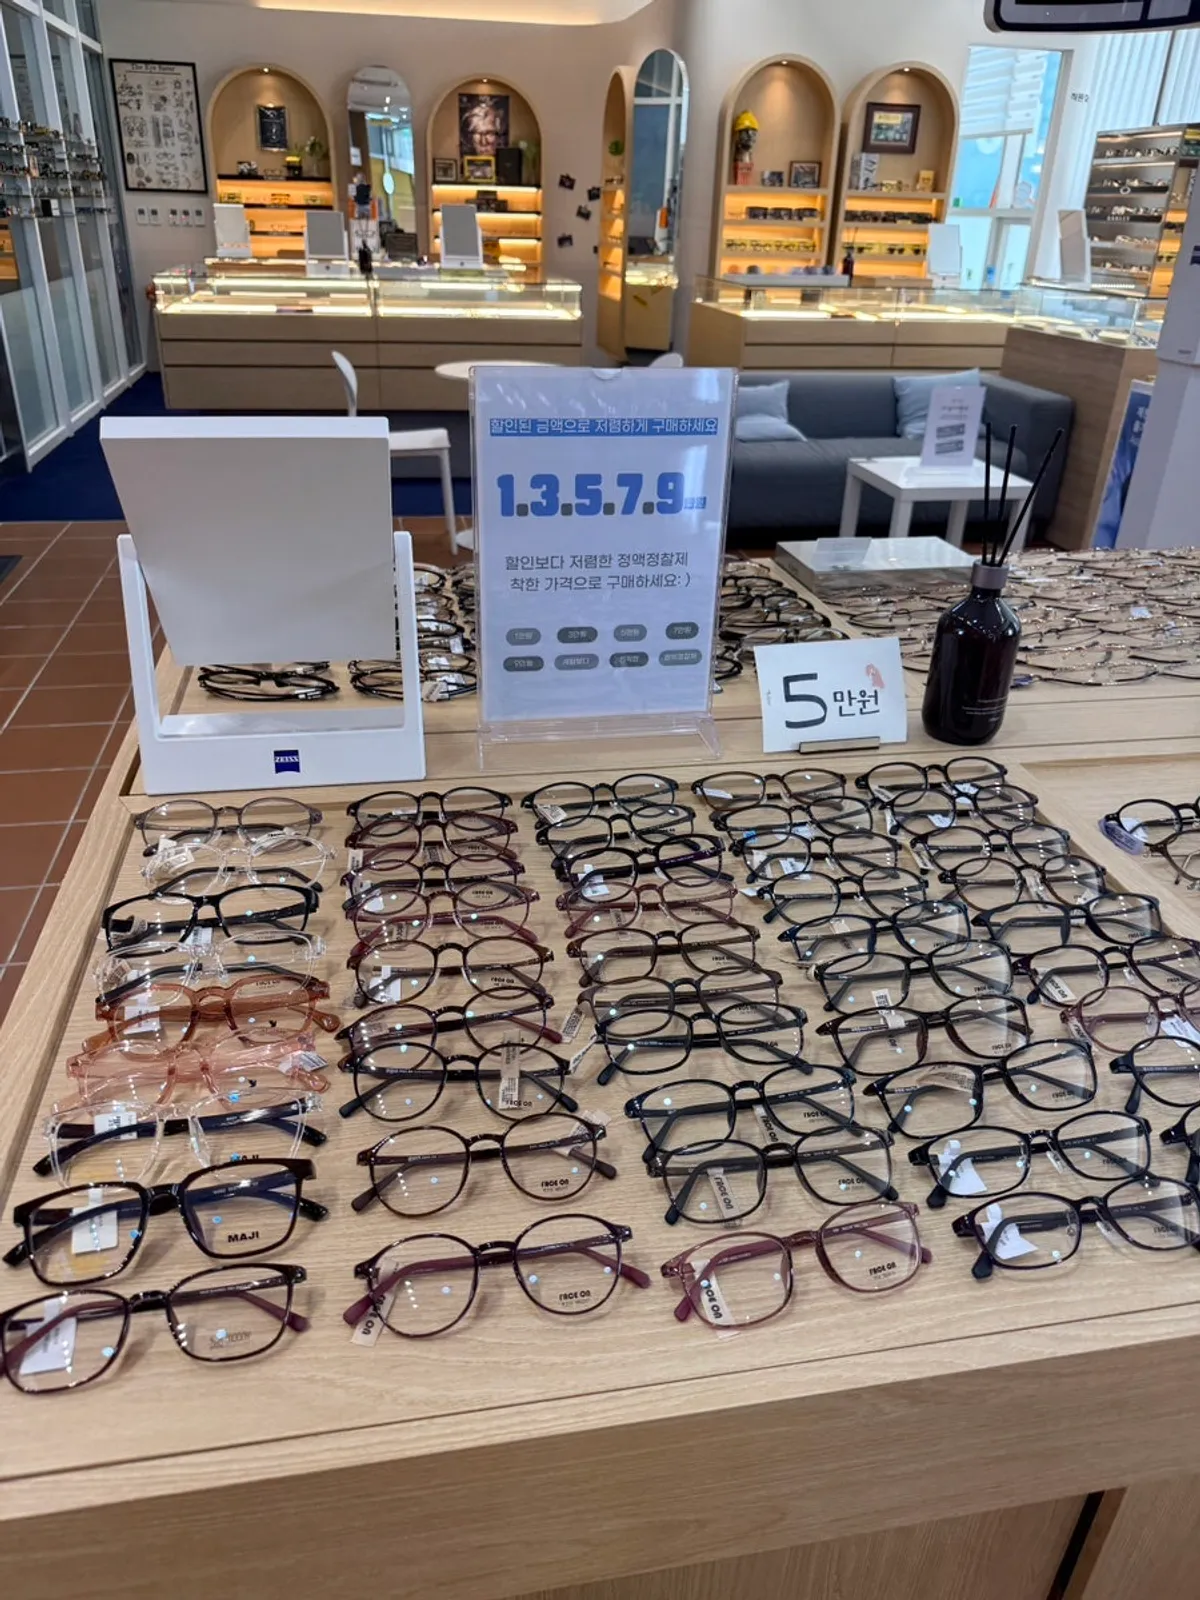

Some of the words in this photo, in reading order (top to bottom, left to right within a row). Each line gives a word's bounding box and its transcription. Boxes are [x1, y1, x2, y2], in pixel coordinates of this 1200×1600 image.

[491, 419, 532, 434] 할인된
[536, 419, 591, 433] 금액으로
[595, 418, 648, 433] 저렴하게
[652, 418, 718, 433] 구매하세요
[505, 555, 565, 571] 할인보다
[569, 554, 613, 569] 저렴한
[617, 552, 688, 568] 정액정찰제
[510, 577, 539, 592] 착한
[545, 575, 602, 591] 가격으로
[228, 1231, 259, 1243] MAJI
